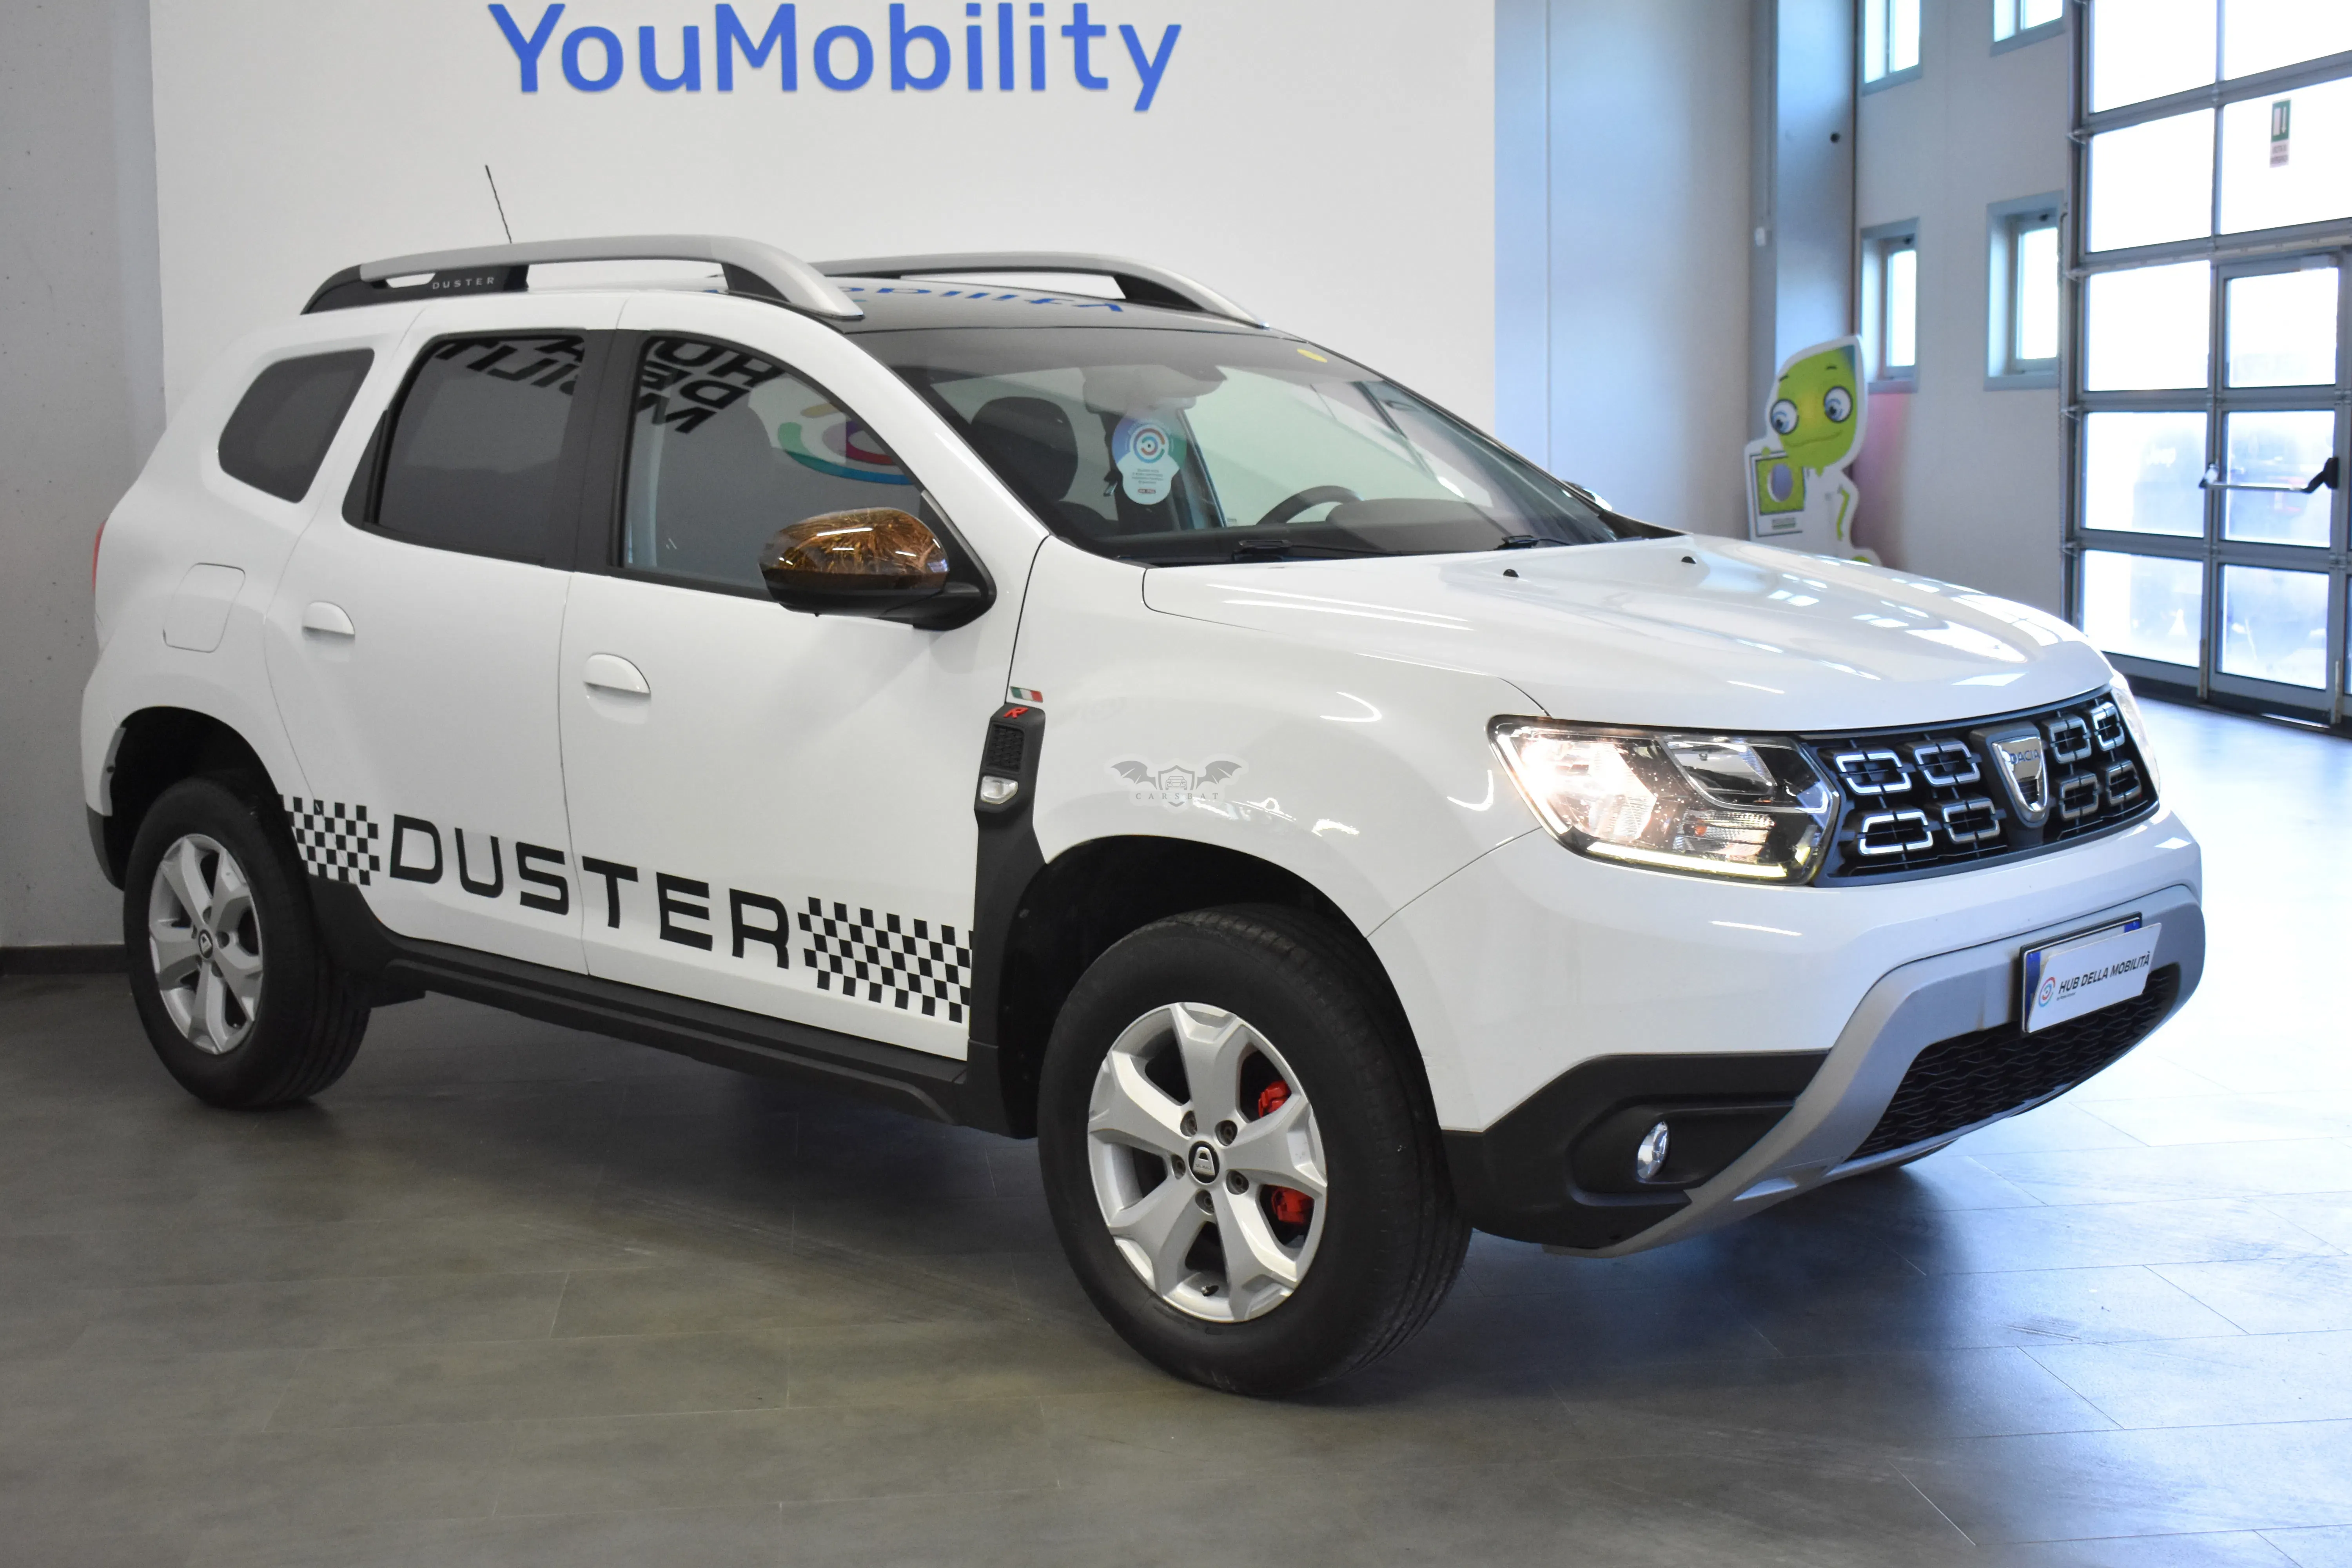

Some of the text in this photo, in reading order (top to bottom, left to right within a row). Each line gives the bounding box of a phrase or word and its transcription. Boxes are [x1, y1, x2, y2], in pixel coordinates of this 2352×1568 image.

[489, 3, 1181, 111] YouMobility
[432, 276, 494, 289] DUSTER
[2009, 749, 2041, 765] DACIA
[390, 815, 789, 969] DUSTER
[2058, 951, 2150, 994] HUB DELLA MOBILITÀ
